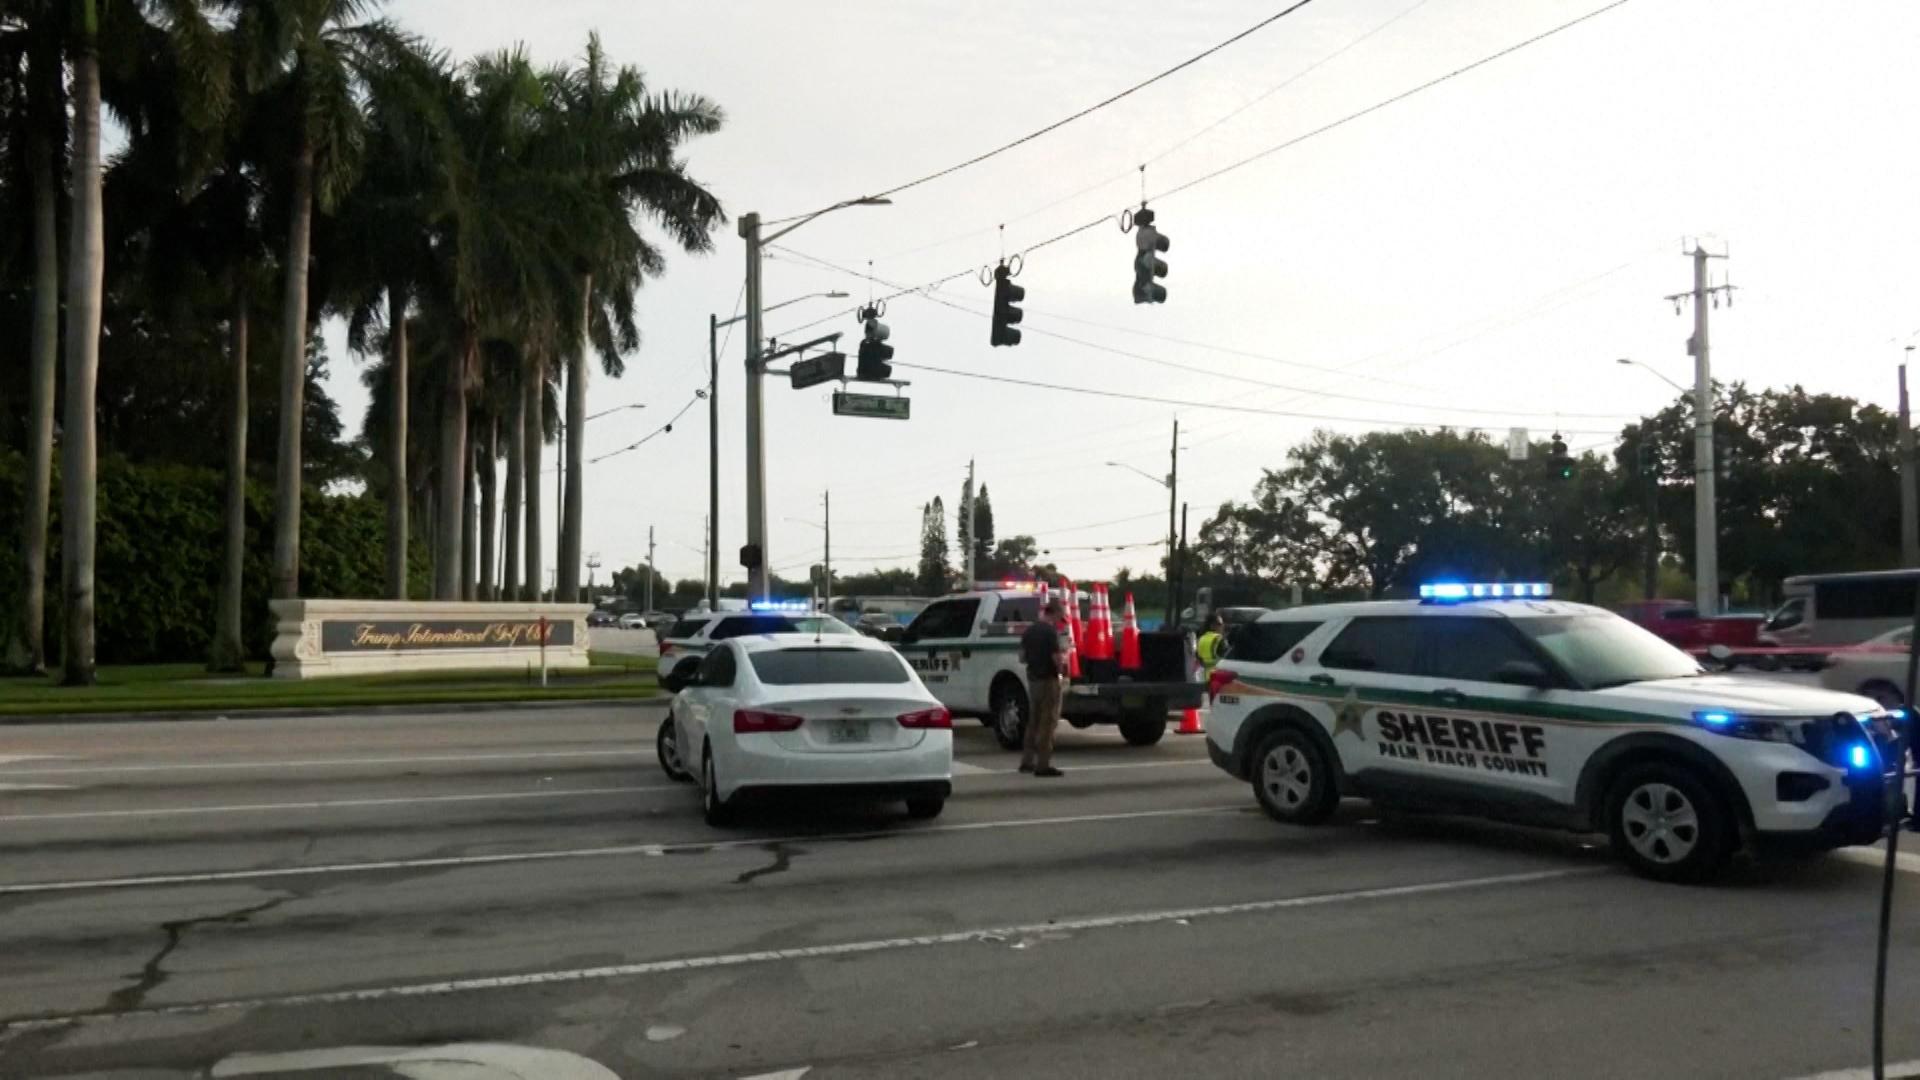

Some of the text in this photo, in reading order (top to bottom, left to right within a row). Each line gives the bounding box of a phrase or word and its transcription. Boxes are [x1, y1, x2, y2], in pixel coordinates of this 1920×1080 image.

[352, 622, 555, 649] Trump International Golf Clb
[1377, 711, 1545, 758] SHERIFF
[1379, 741, 1548, 777] PALM BEACH COUNTY
